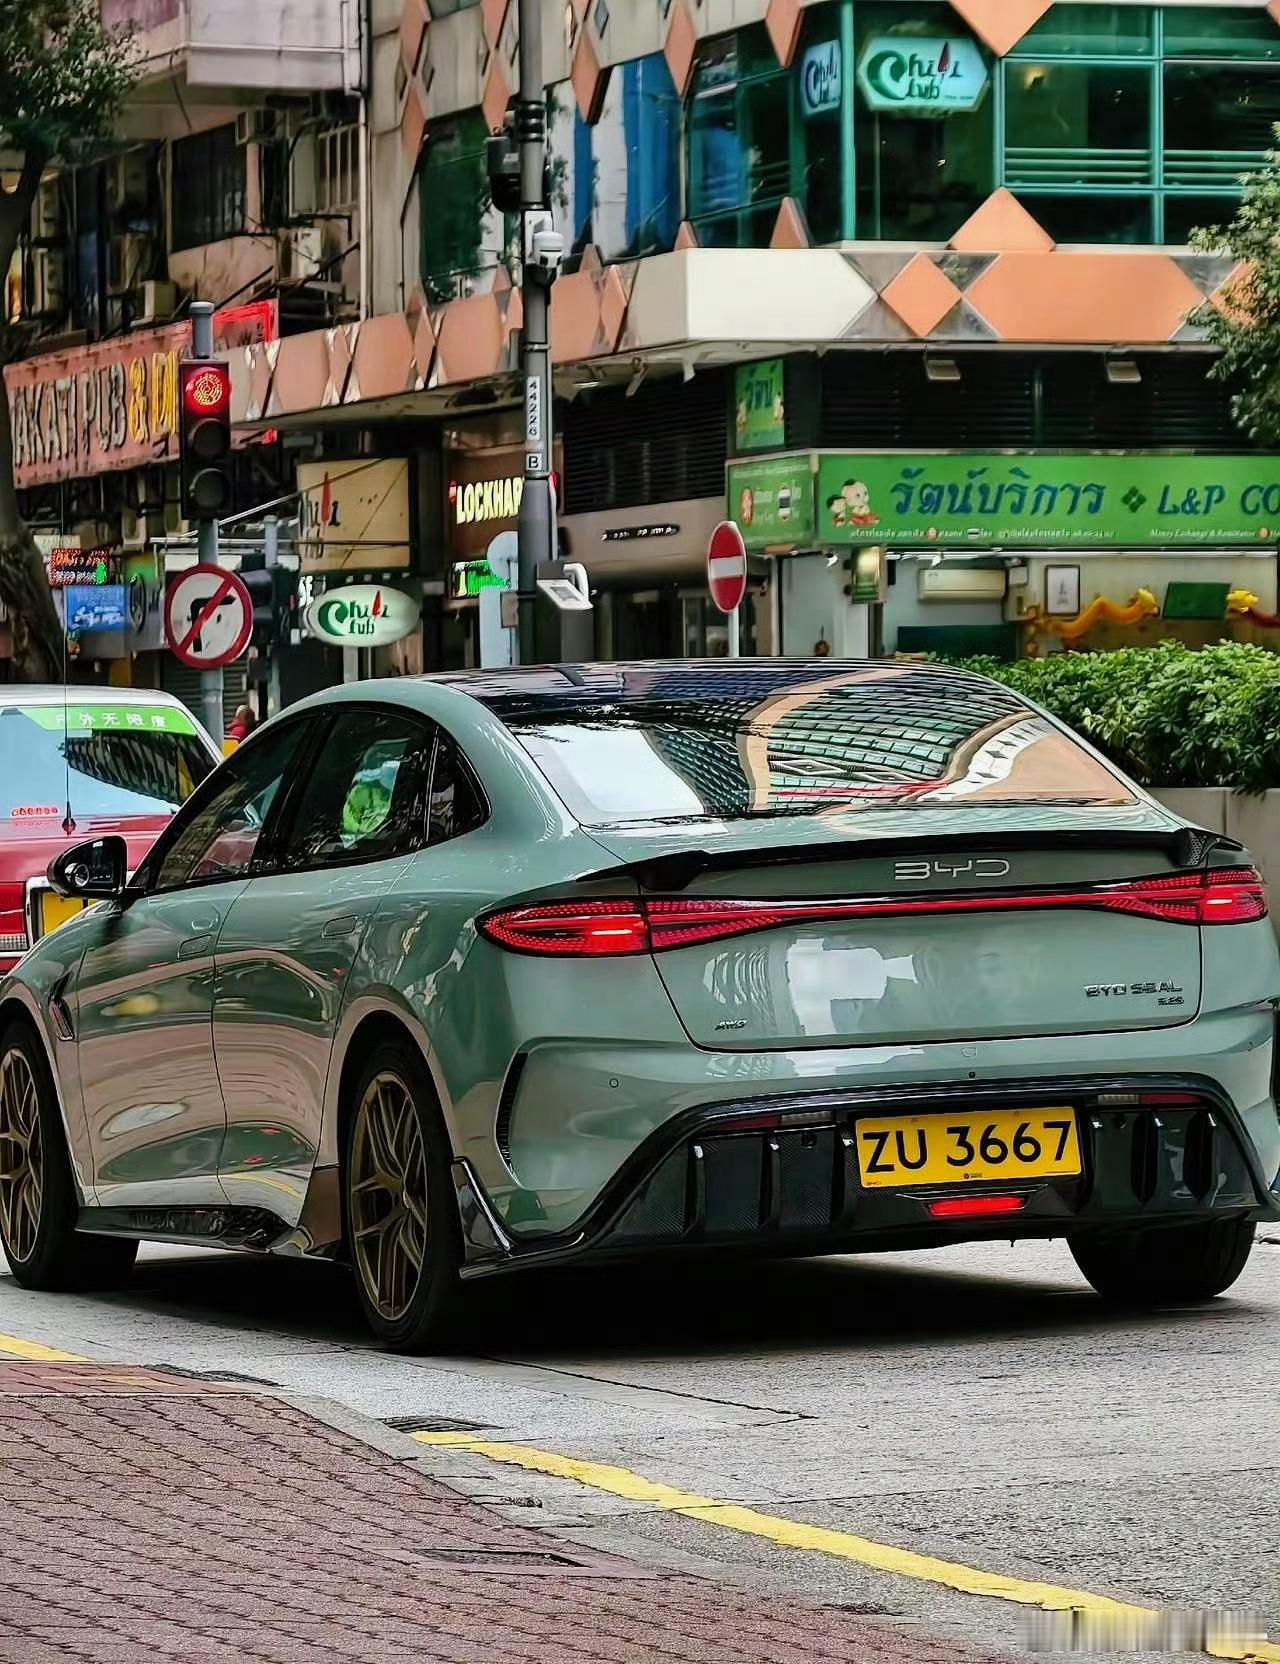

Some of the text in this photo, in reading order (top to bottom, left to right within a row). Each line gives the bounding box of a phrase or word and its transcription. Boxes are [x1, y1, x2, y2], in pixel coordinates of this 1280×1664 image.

[82, 361, 127, 455] PUB
[129, 356, 149, 445] &
[528, 456, 539, 469] B
[456, 477, 525, 525] LOCKHAR
[1157, 484, 1226, 516] L&P
[894, 859, 1010, 881] BYD
[1085, 979, 1183, 998] BYD SEAL
[862, 1120, 1072, 1174] ZU 3667
